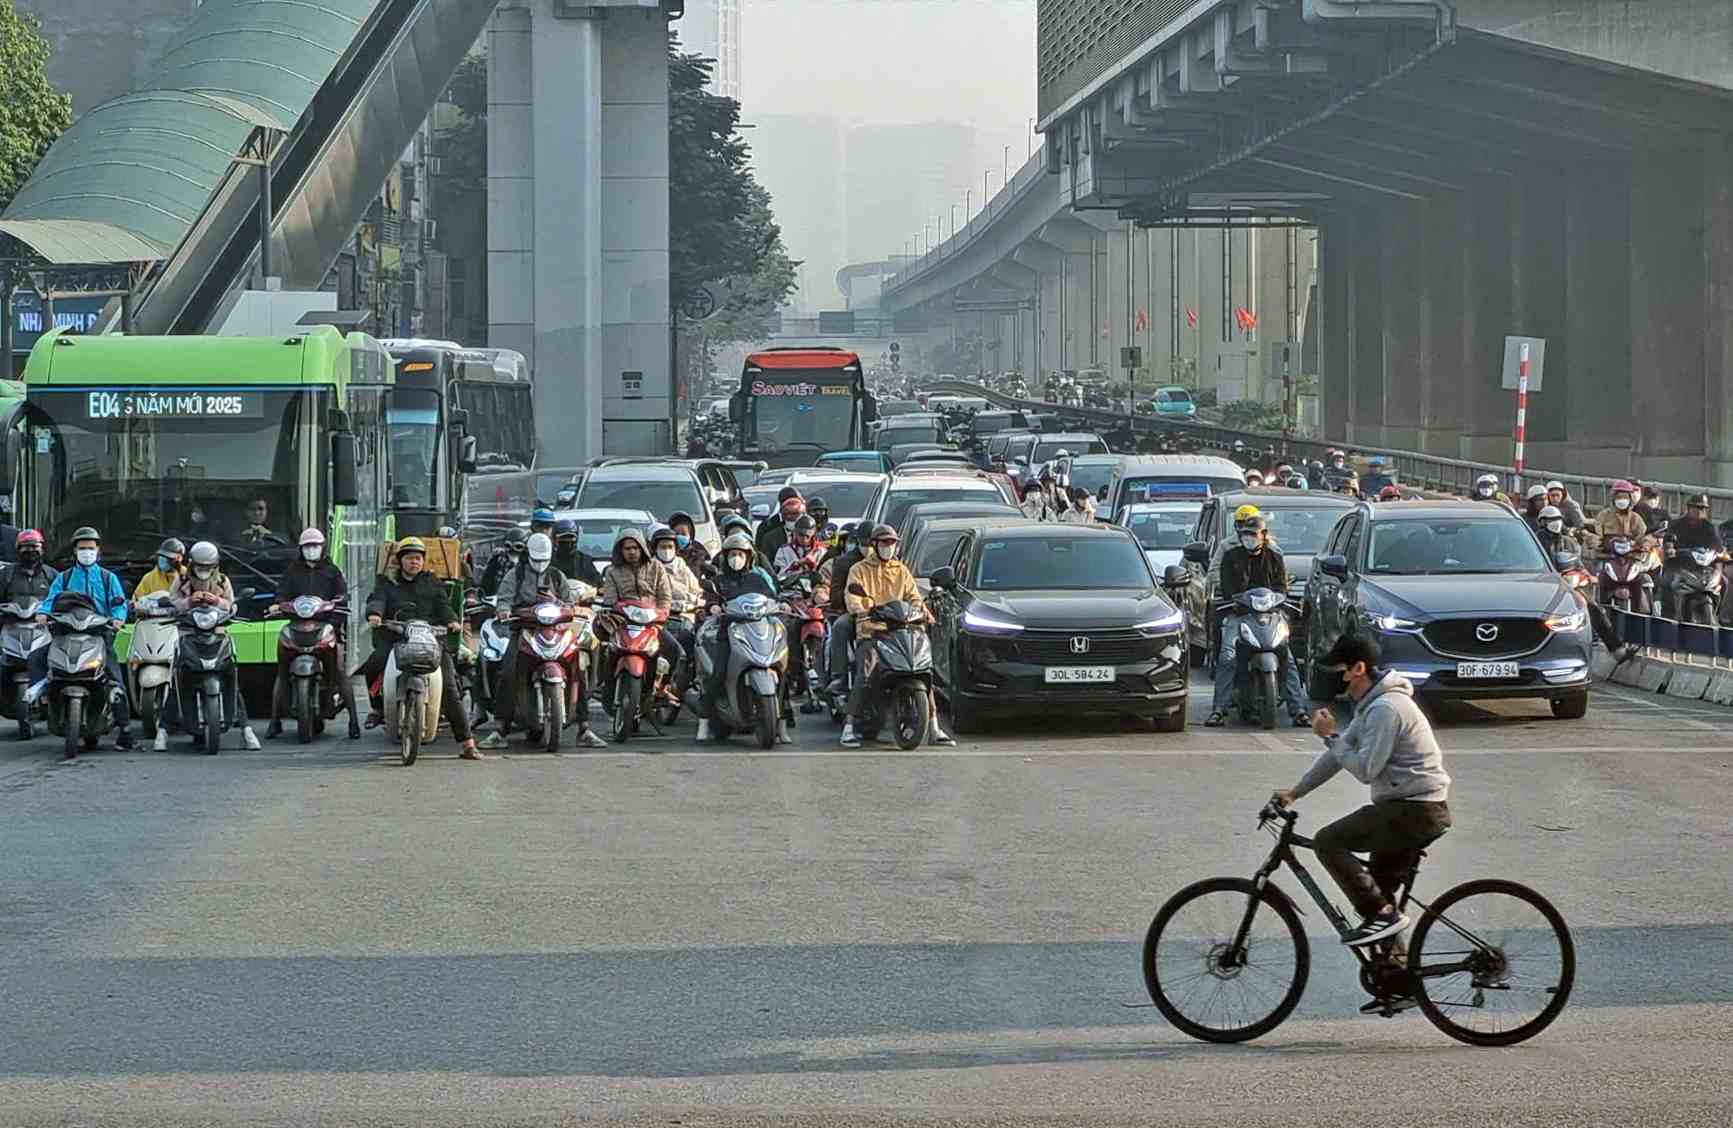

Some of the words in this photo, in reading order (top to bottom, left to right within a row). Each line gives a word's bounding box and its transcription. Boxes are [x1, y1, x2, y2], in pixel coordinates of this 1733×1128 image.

[89, 392, 120, 417] E04
[137, 392, 172, 414] NĂM
[176, 392, 202, 414] MỚI
[206, 396, 242, 414] 2025
